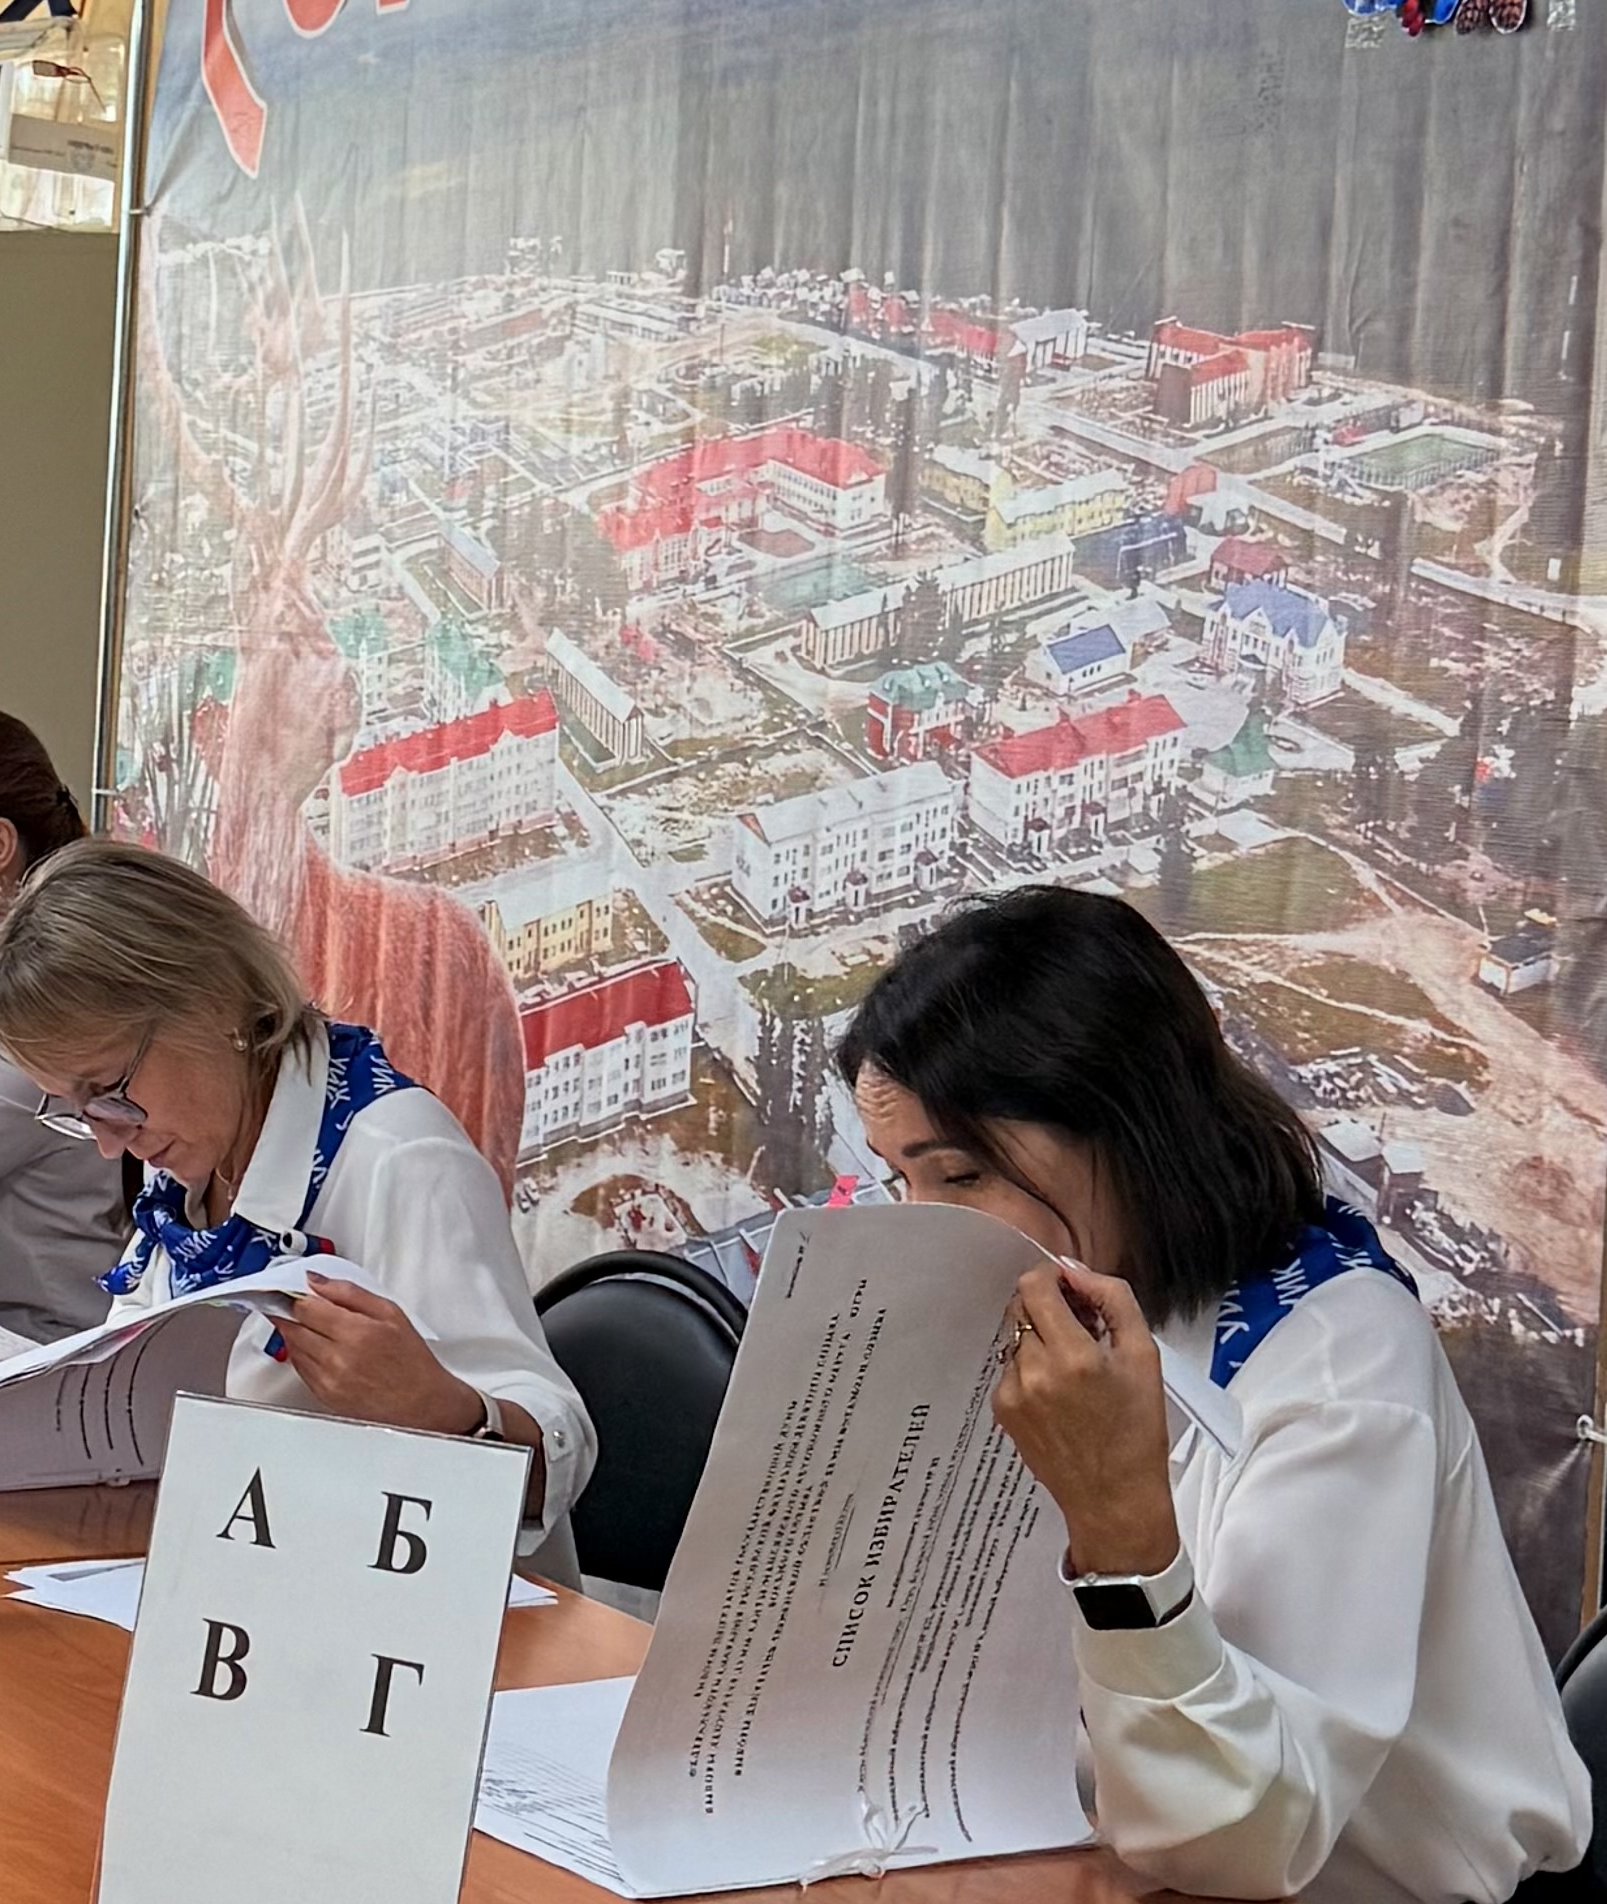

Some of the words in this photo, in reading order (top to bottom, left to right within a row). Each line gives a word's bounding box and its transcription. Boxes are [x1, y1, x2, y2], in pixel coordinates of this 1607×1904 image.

[215, 1467, 277, 1549] А
[367, 1490, 433, 1575] Б
[832, 1573, 876, 1668] СПИСОК
[864, 1403, 931, 1569] ИЗБИРАТЕЛЕЙ
[189, 1617, 251, 1701] В
[358, 1653, 425, 1738] Г
